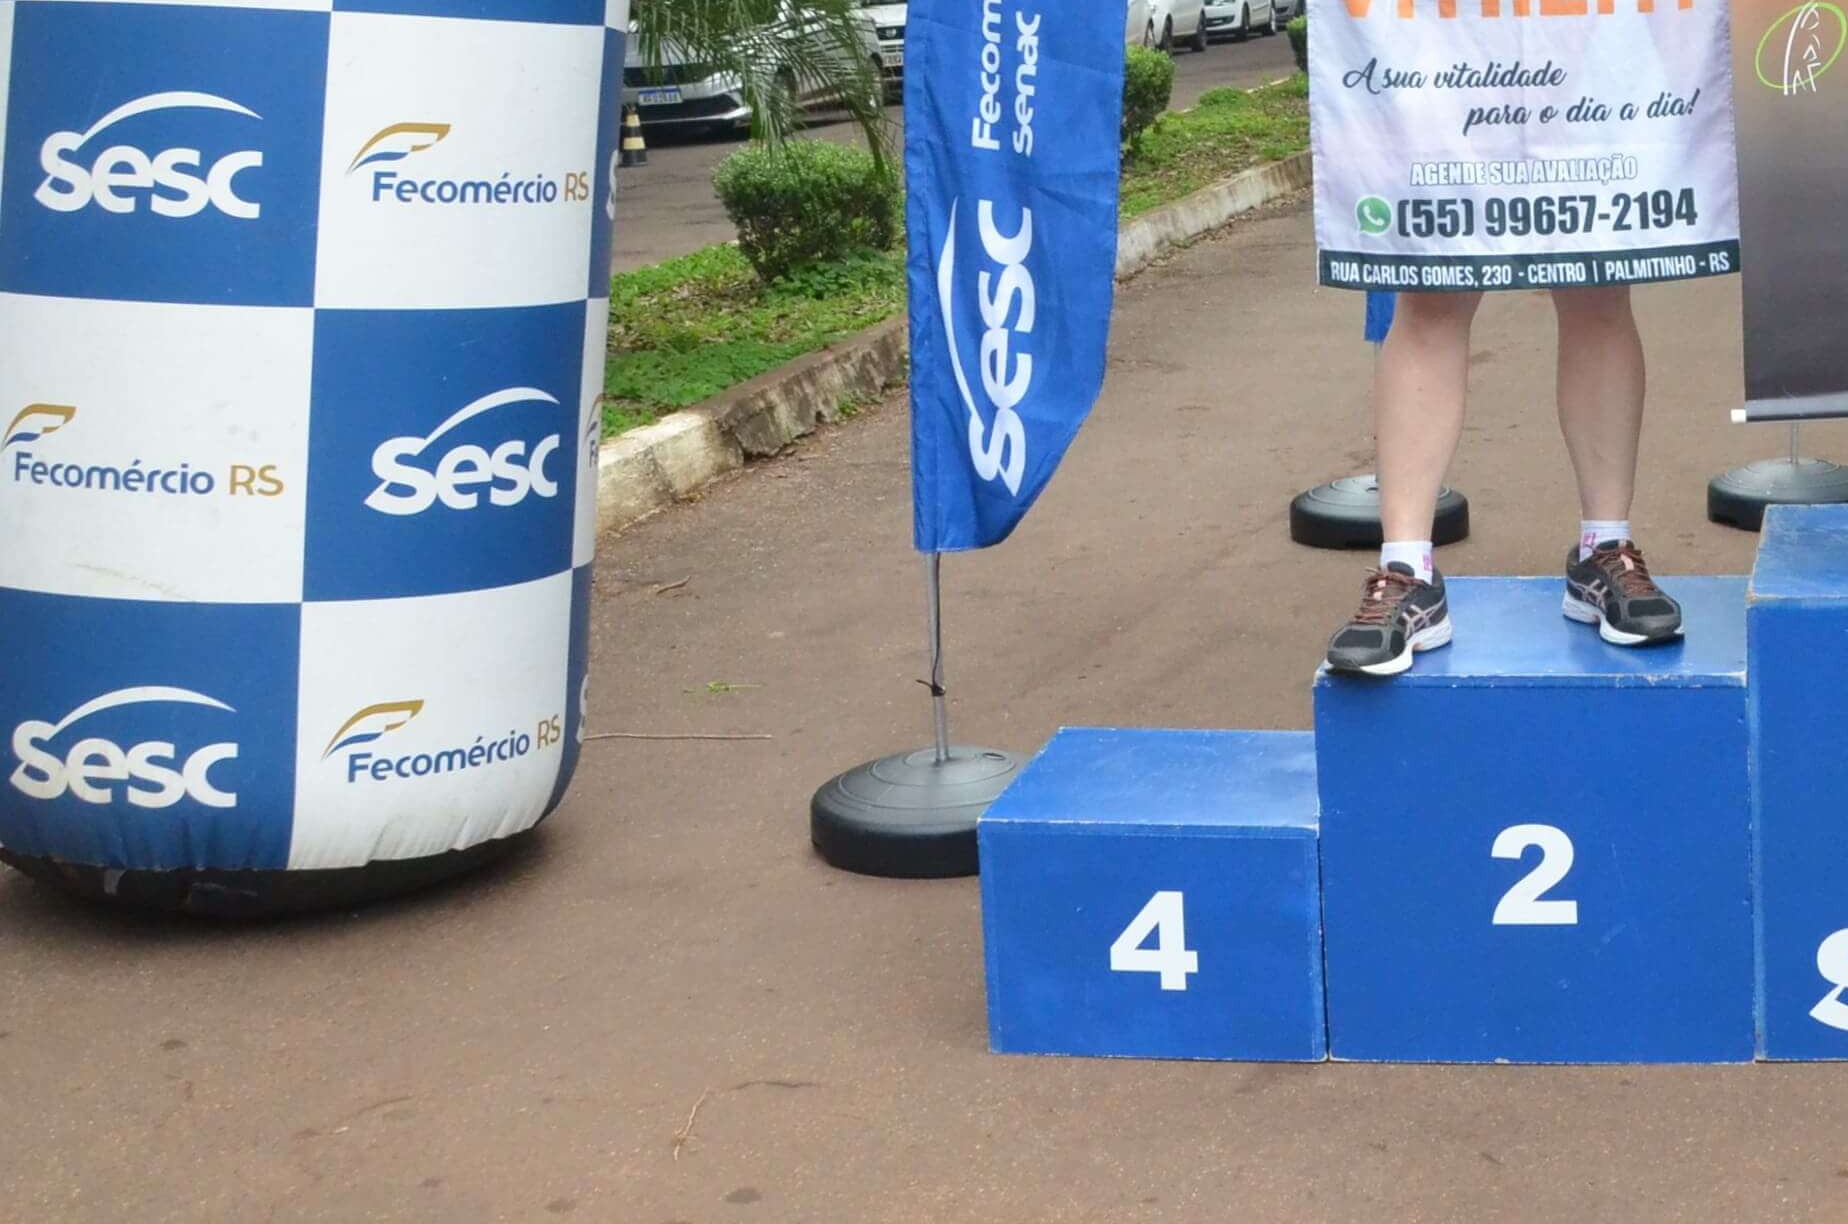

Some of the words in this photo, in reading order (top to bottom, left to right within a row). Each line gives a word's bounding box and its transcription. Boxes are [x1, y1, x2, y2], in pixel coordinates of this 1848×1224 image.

[1343, 57, 1380, 95] A
[1382, 68, 1428, 90] sua
[1433, 60, 1567, 90] vitalidade
[1463, 102, 1532, 136] para
[1539, 105, 1559, 124] o
[1566, 96, 1612, 123] dia
[1619, 104, 1639, 122] a
[1646, 89, 1701, 119] dia!
[372, 171, 557, 205] Fecomércio
[564, 172, 589, 202] RS
[1410, 161, 1487, 186] AGENDE
[1489, 159, 1529, 185] SUA
[1531, 153, 1638, 185] AVALIAÇÃO
[1398, 198, 1474, 238] (55)
[1485, 187, 1698, 237] 99657-2194
[1330, 261, 1360, 283] RUA
[1362, 263, 1418, 285] CARLOS
[1421, 265, 1478, 287] GOMES,
[1482, 265, 1511, 286] 230
[1528, 263, 1586, 283] CENTRO
[1605, 255, 1695, 280] PALMITINHO
[1709, 251, 1730, 272] RS
[13, 451, 214, 495] Fecomércio
[229, 464, 284, 497] RS
[347, 727, 530, 784] Fecomércio
[537, 714, 560, 751] RS
[1490, 824, 1578, 925] 2
[1110, 890, 1198, 991] 4
